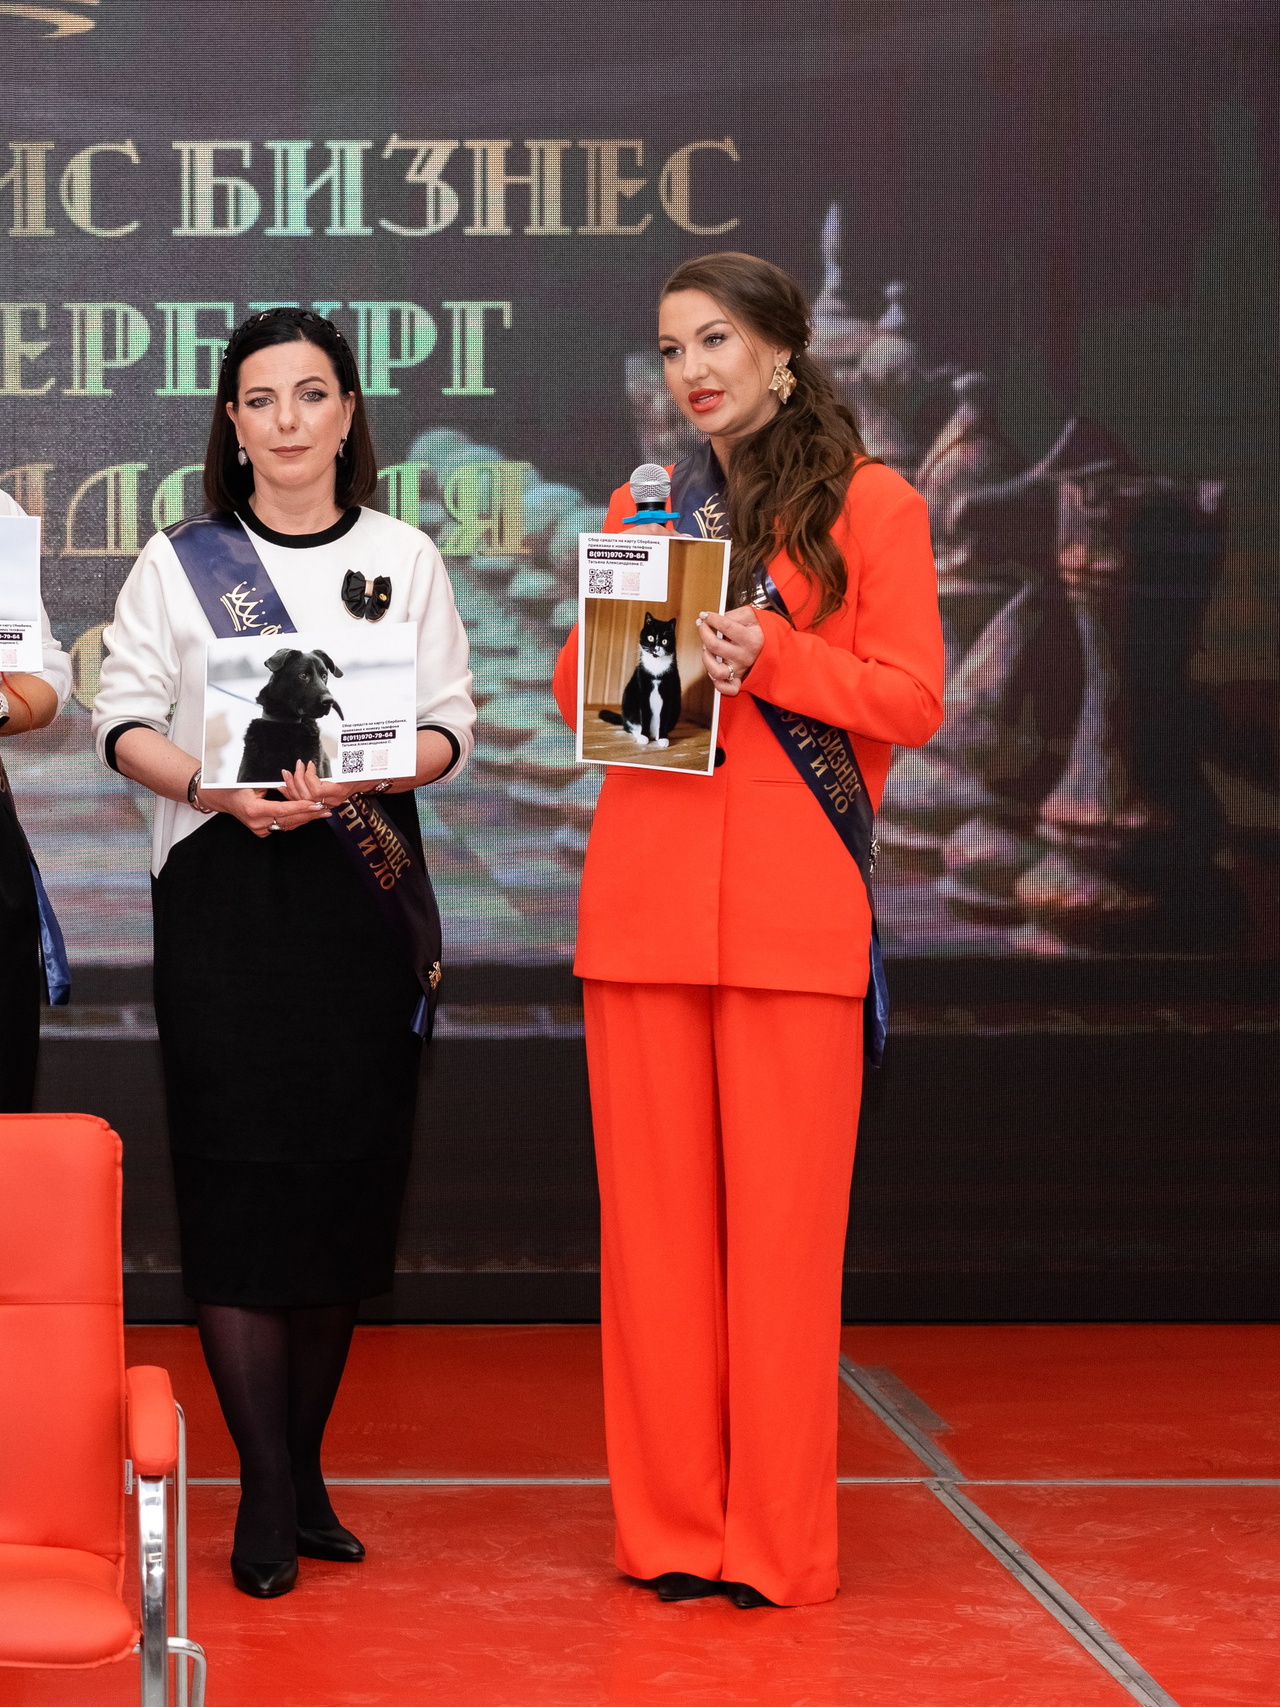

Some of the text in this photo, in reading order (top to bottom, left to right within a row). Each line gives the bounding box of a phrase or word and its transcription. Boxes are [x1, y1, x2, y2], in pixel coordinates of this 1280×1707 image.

[172, 133, 742, 238] БИЗНЕС
[589, 551, 645, 559] 8(911)970-79-64
[342, 732, 393, 742] 8(911)970-79-64
[817, 727, 862, 803] БИЗНЕС
[810, 753, 849, 814] И ЛО
[357, 834, 379, 858] И
[369, 860, 396, 891] ЛО
[367, 807, 412, 879] БИЗНЕС
